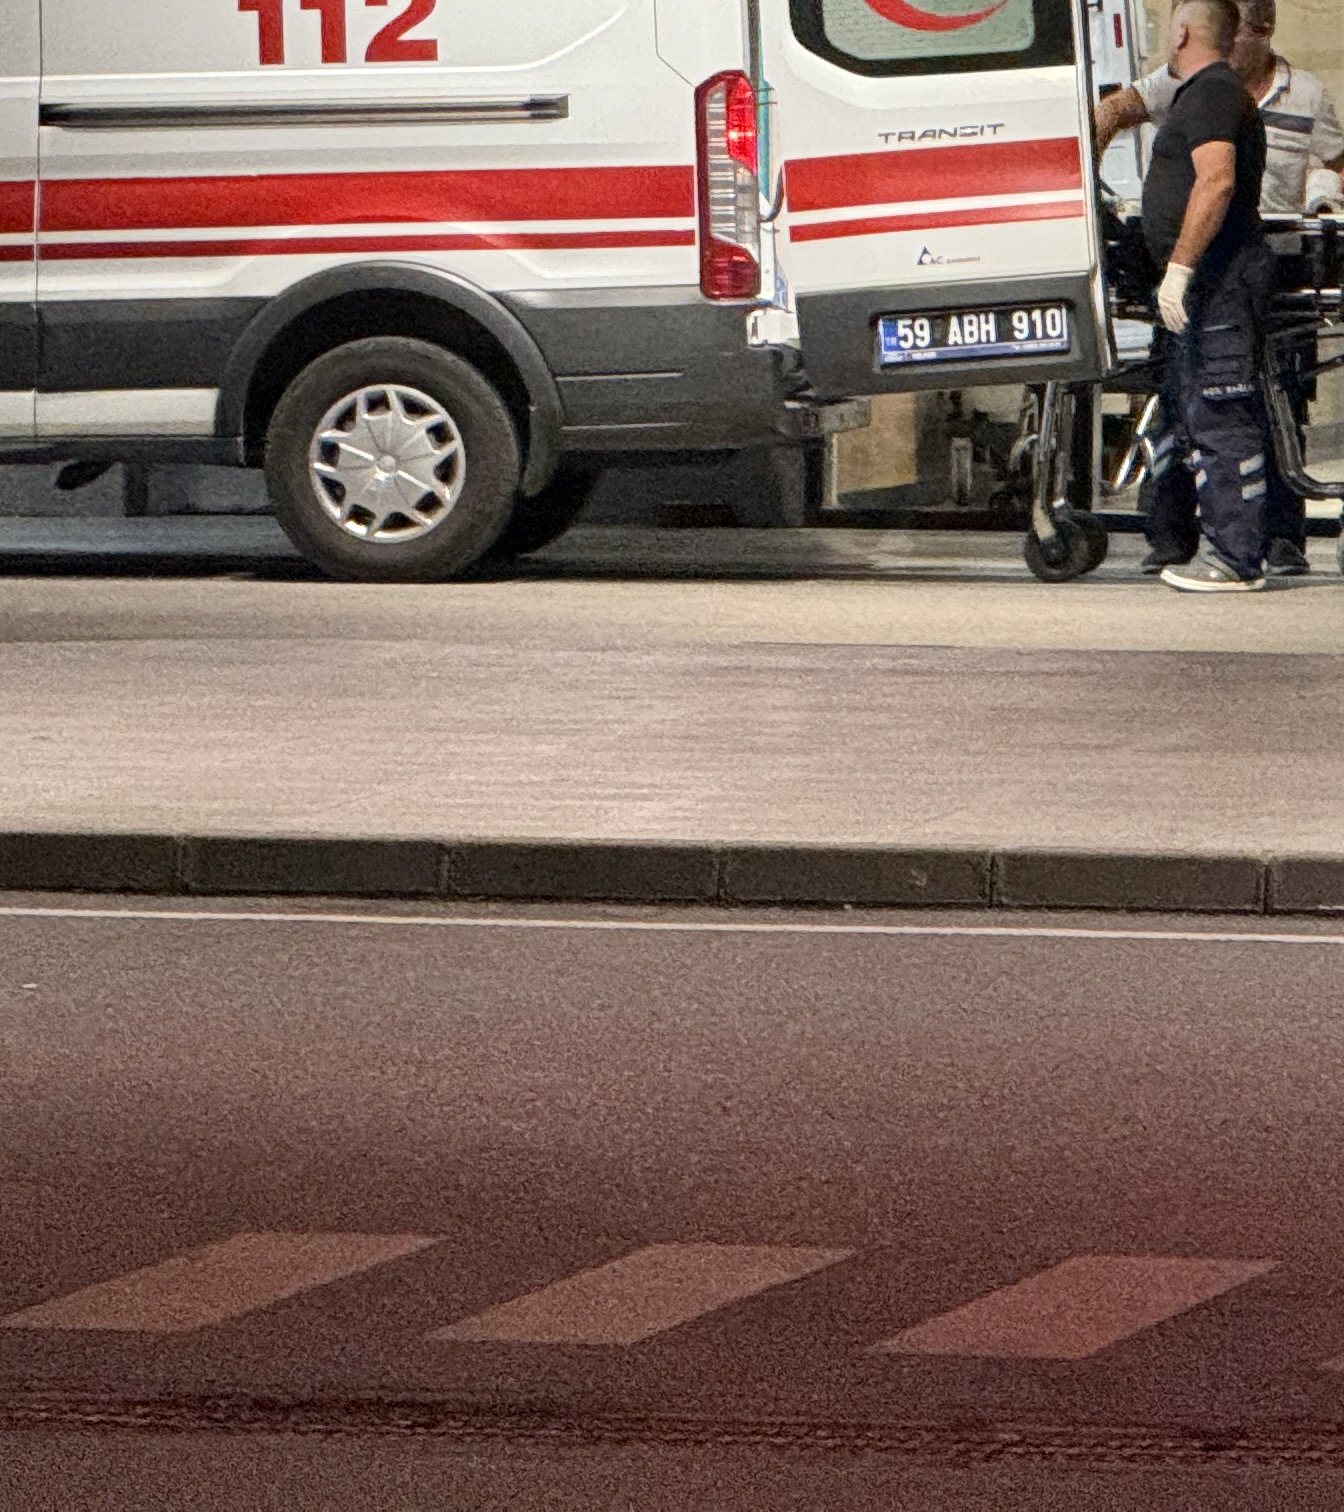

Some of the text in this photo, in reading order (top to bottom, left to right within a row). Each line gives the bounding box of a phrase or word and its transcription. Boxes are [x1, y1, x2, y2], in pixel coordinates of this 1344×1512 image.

[877, 123, 1005, 144] TRANSIT
[897, 317, 931, 349] 59
[948, 311, 997, 346] ABH
[1011, 307, 1062, 340] 910
